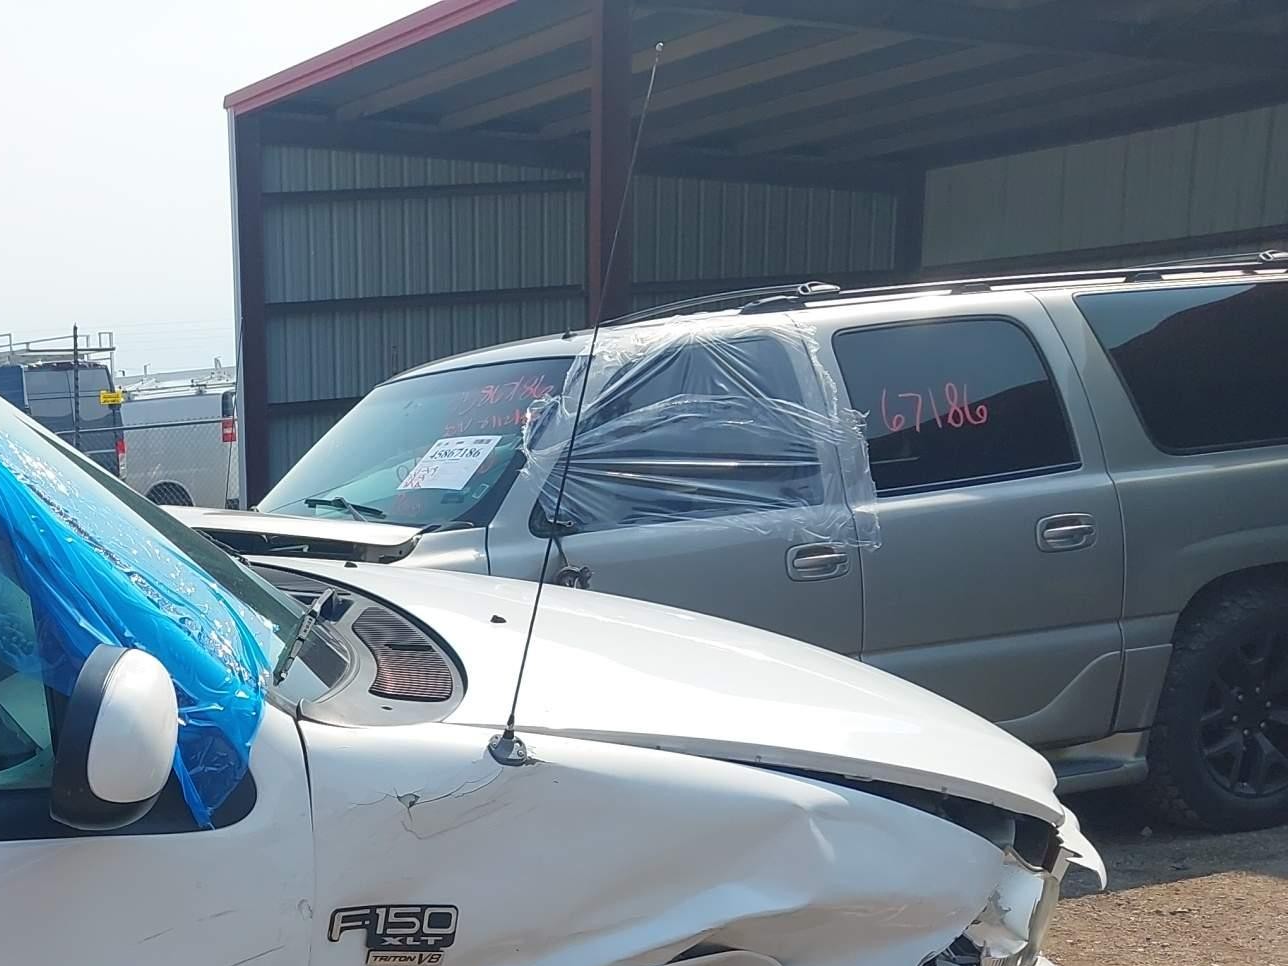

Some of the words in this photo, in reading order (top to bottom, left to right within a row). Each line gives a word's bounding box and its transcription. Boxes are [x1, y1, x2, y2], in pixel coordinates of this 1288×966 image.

[881, 382, 988, 432] 67186
[379, 936, 444, 946] XLT
[371, 955, 417, 963] TRITON
[415, 953, 442, 965] V8
